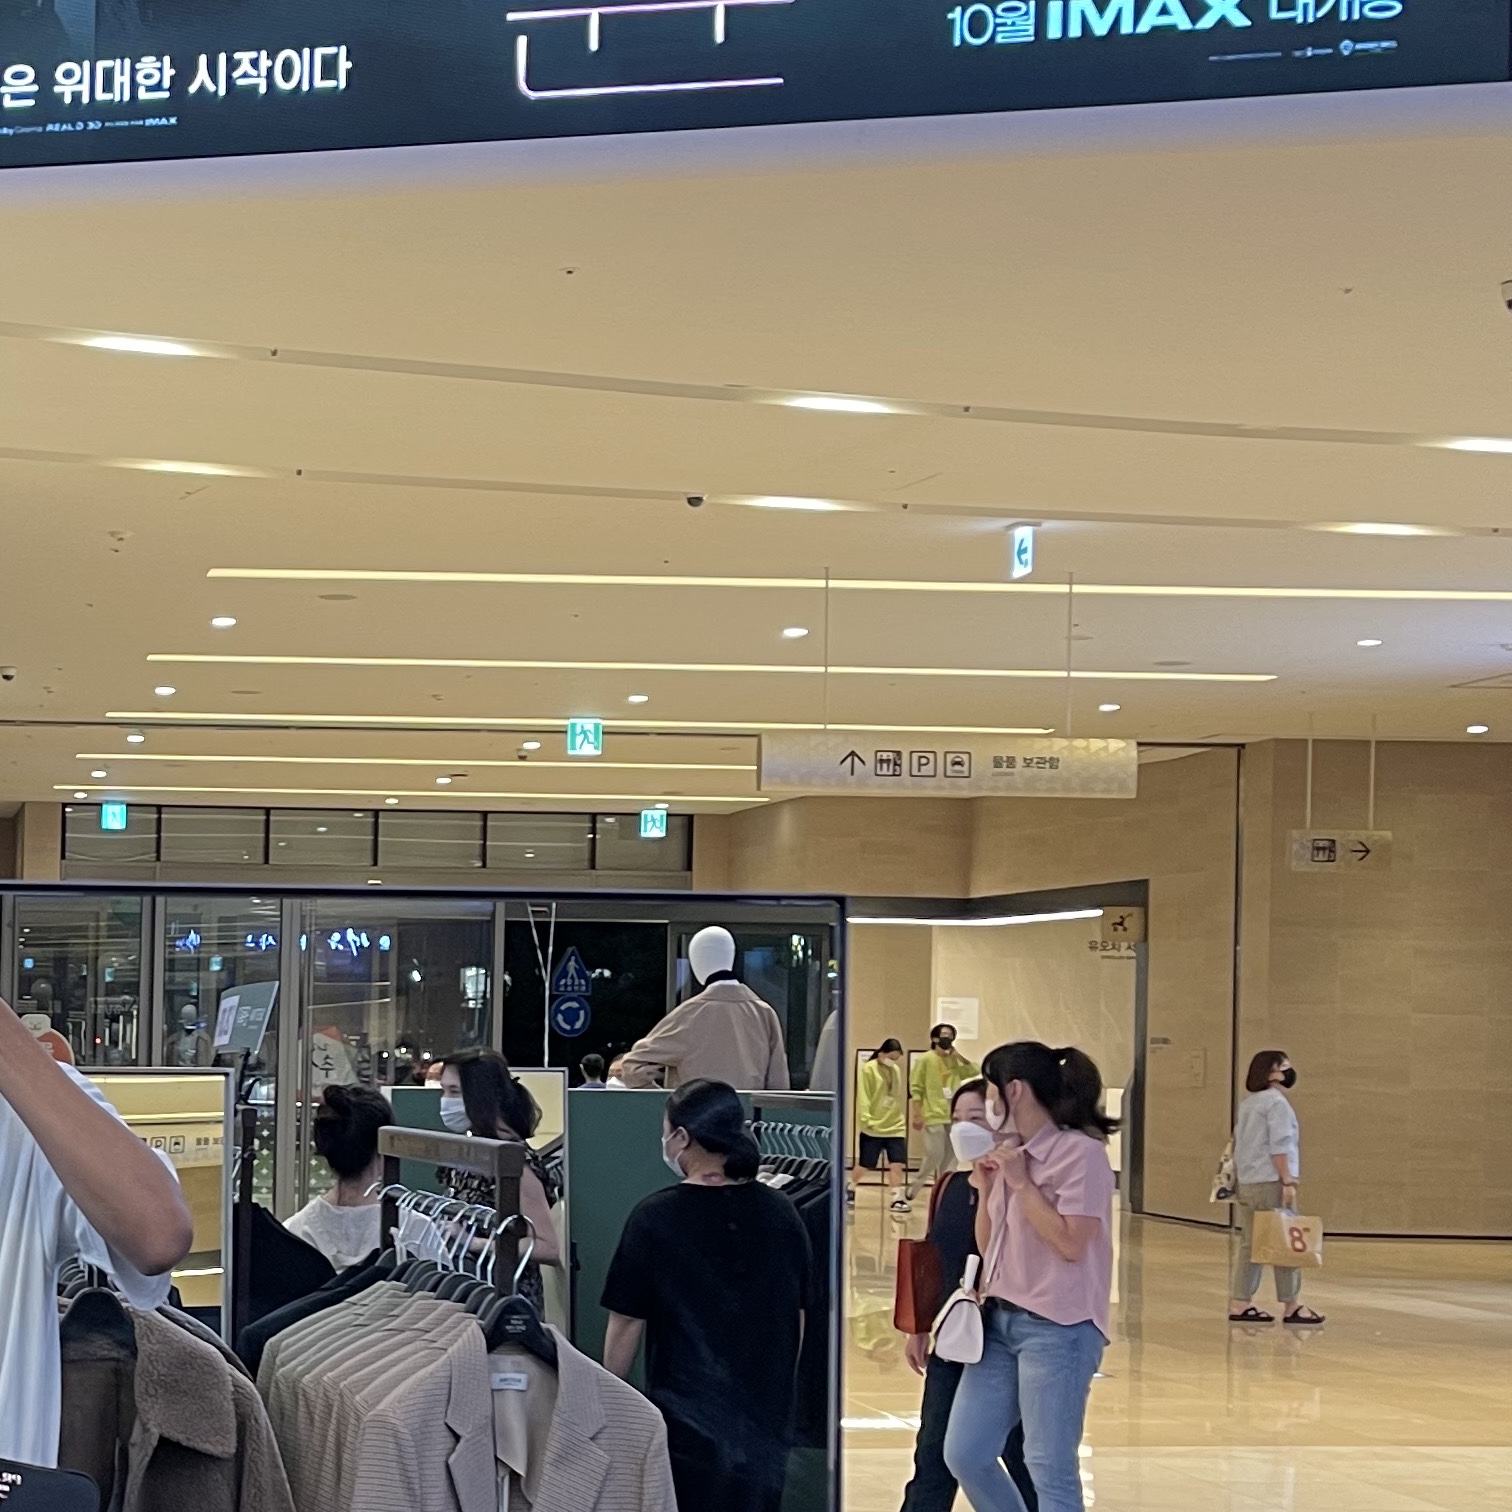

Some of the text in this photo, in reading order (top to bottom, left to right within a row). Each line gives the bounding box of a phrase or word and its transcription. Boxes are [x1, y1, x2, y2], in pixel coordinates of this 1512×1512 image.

[946, 0, 1037, 47] 10월
[1046, 0, 1253, 40] IMAX
[52, 55, 177, 105] 위대한
[188, 44, 353, 98] 시작이다
[1021, 755, 1061, 770] 보관함
[1288, 1226, 1308, 1253] 8
